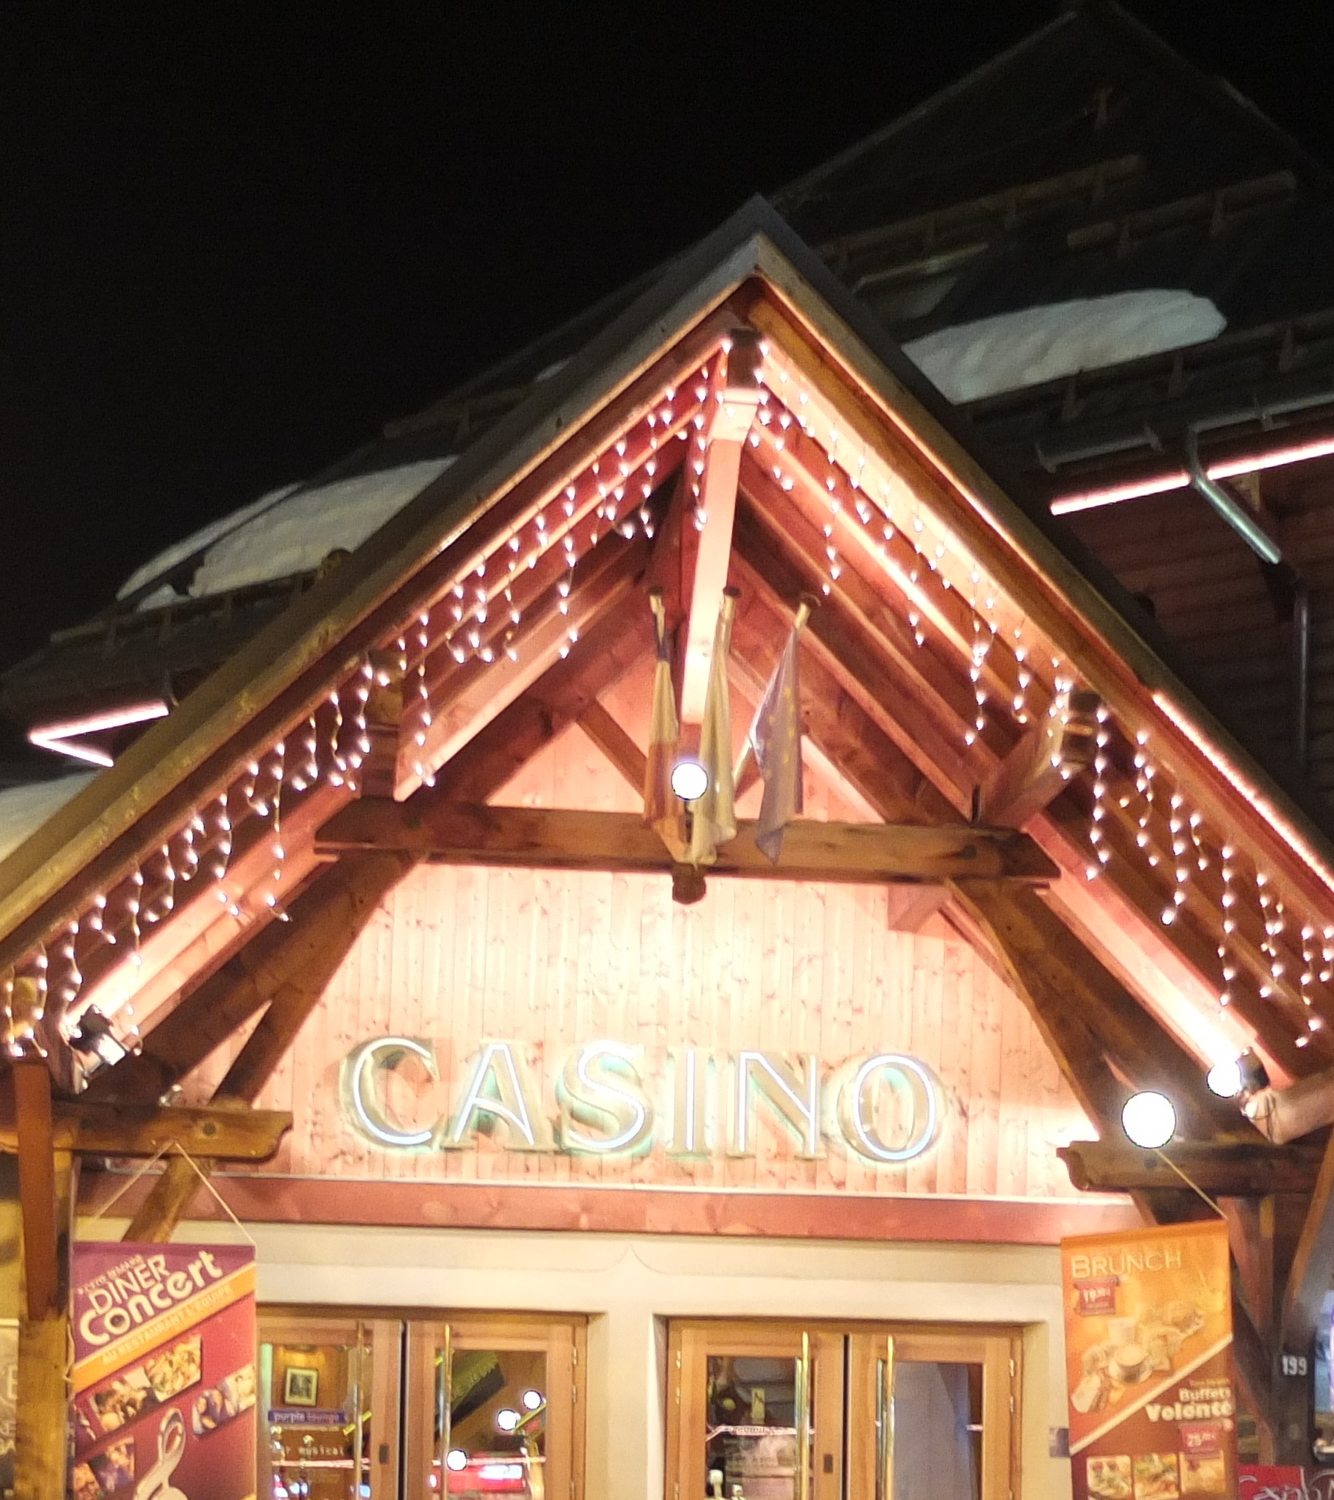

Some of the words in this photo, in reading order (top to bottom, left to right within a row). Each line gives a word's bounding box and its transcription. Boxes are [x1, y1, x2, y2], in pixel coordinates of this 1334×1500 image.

[337, 1035, 945, 1164] CASINO
[88, 1254, 171, 1316] DINER
[1071, 1251, 1182, 1279] BRUNCH
[79, 1250, 223, 1346] Concert
[1281, 1355, 1308, 1376] 199
[273, 1411, 305, 1423] purple
